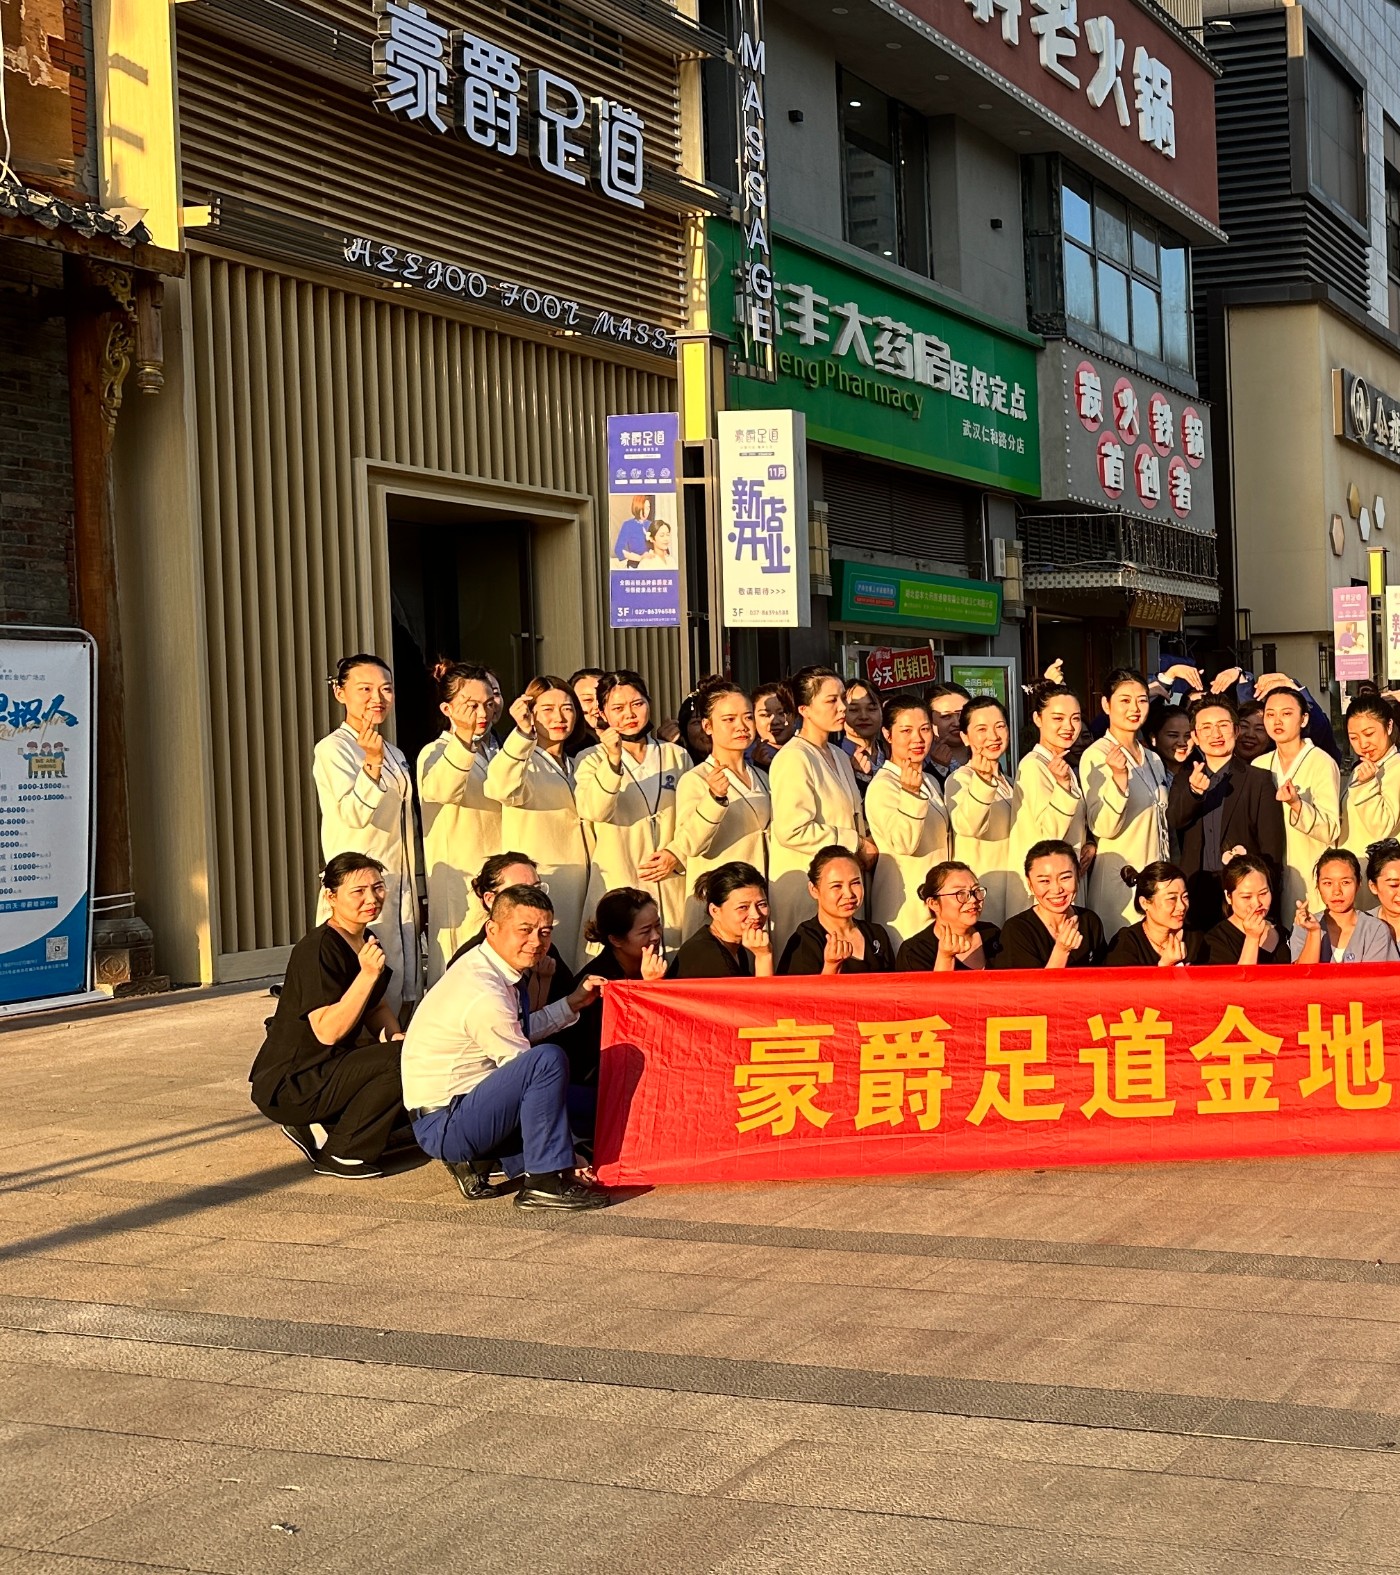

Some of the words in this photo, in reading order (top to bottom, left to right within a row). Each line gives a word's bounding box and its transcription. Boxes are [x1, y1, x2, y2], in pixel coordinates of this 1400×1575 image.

[378, 1, 645, 209] 豪爵足道
[739, 31, 773, 346] MASSAGE
[344, 237, 487, 298] HEEJOO
[500, 281, 580, 325] FOOT
[950, 359, 1028, 421] 医保定点
[1075, 370, 1206, 460] 炭火铁锅
[962, 419, 1025, 455] 武汉仁和路分店
[768, 467, 786, 478] 11月
[1098, 441, 1192, 511] 首创者
[617, 607, 630, 617] 3F
[732, 608, 744, 617] 3F
